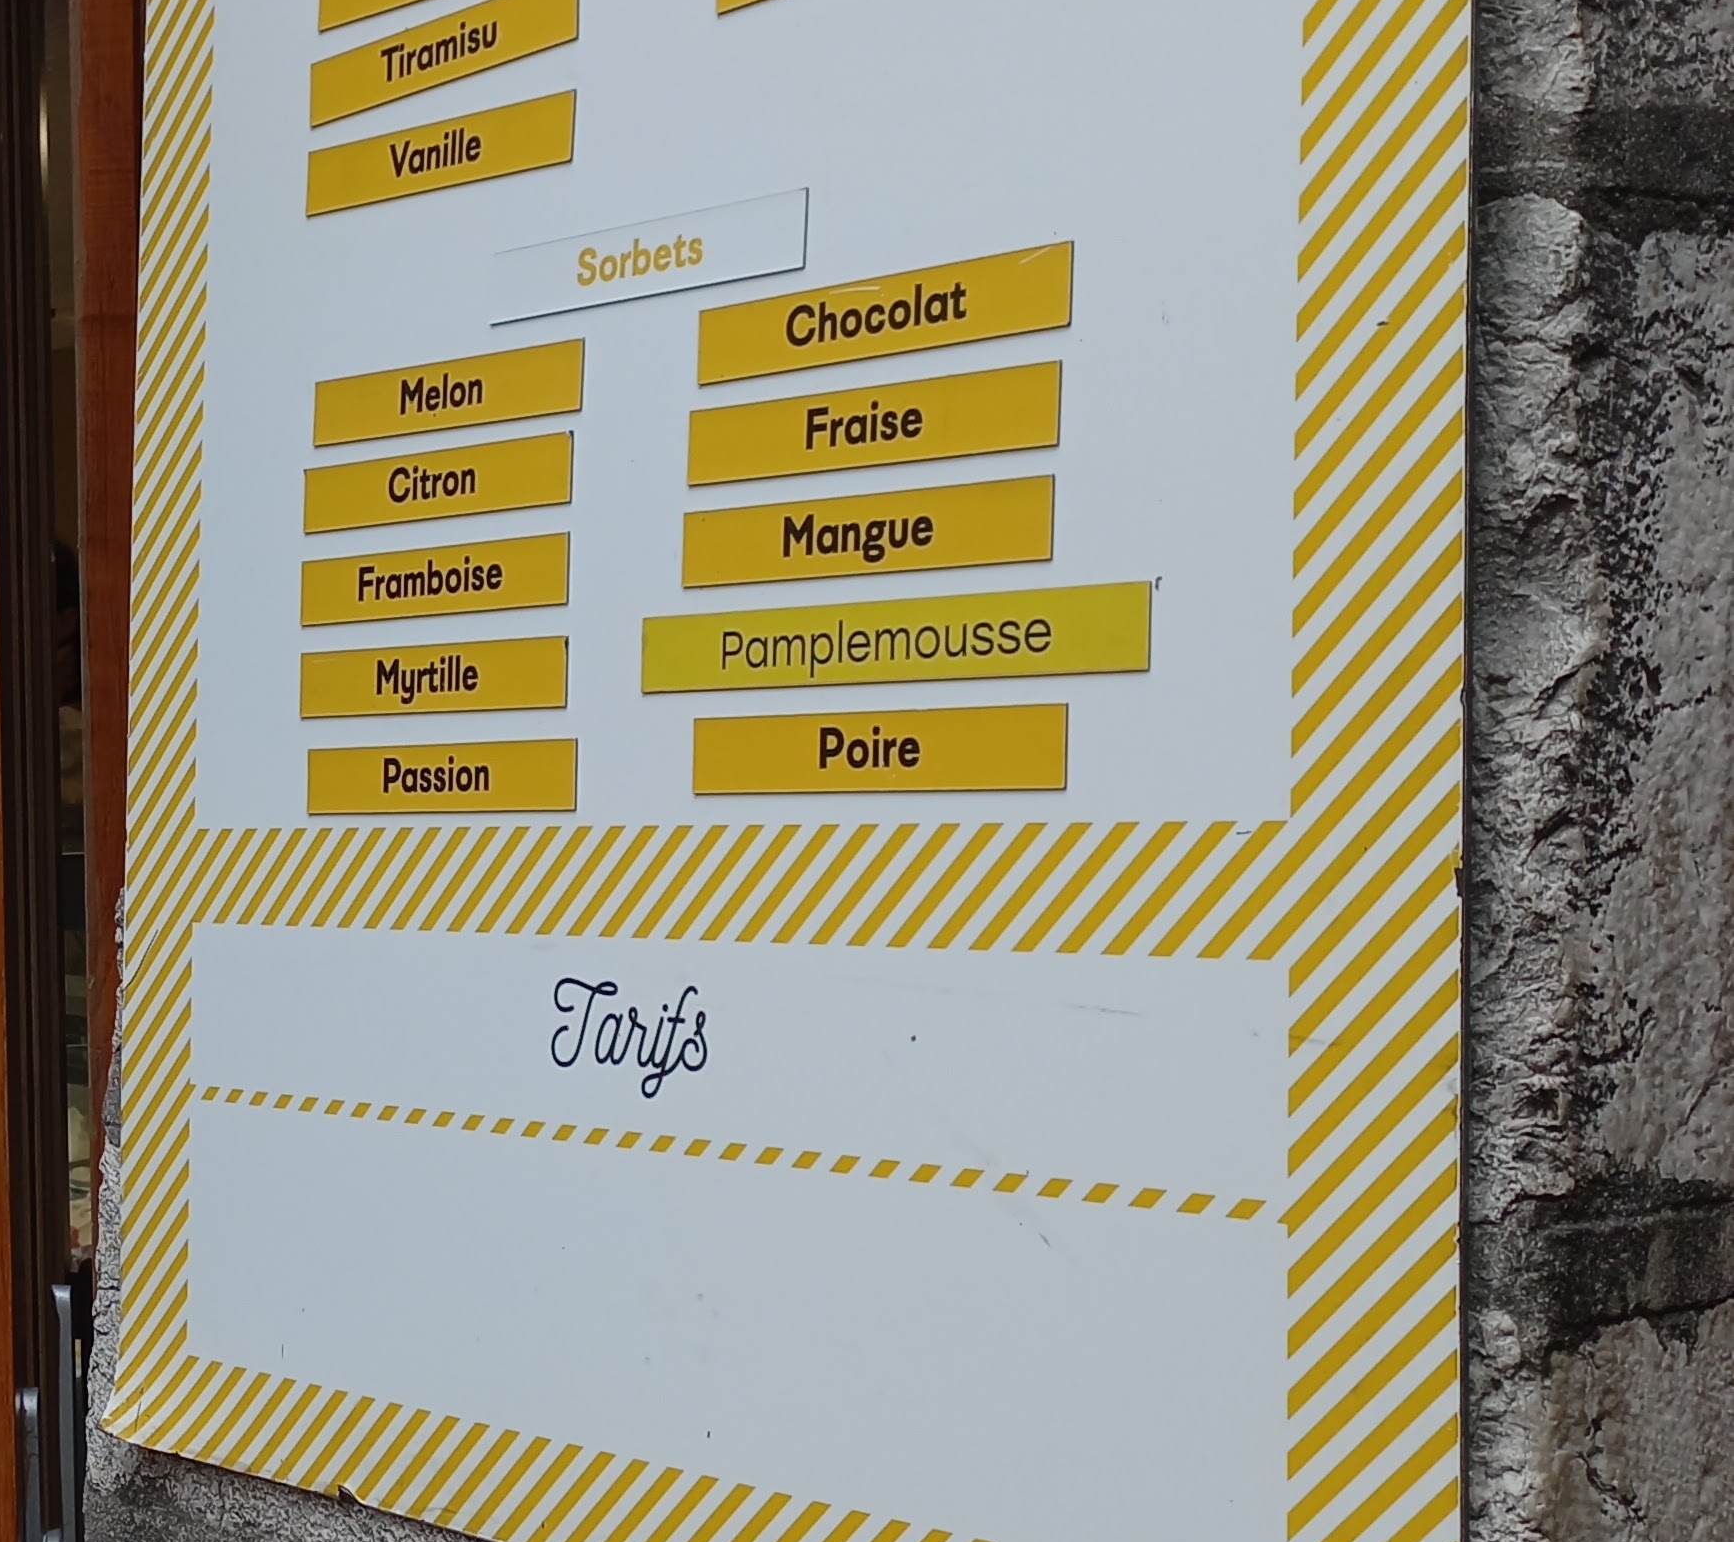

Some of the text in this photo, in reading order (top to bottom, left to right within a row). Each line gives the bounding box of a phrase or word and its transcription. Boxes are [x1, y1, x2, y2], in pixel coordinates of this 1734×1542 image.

[380, 19, 498, 83] Tiramisu
[389, 127, 482, 179] Vanille
[576, 234, 704, 286] Sorbets
[785, 281, 967, 347] Chocolat
[399, 373, 484, 416] Melon
[805, 400, 924, 451] Fraise
[387, 464, 477, 504] Citron
[782, 513, 934, 563] Mangue
[357, 555, 504, 602] Framboise
[721, 615, 1052, 678] Pamplemousse
[375, 655, 479, 704] Myrtille
[818, 725, 921, 769] Poire
[382, 755, 491, 793] Passion
[551, 977, 709, 1099] Tarifs
